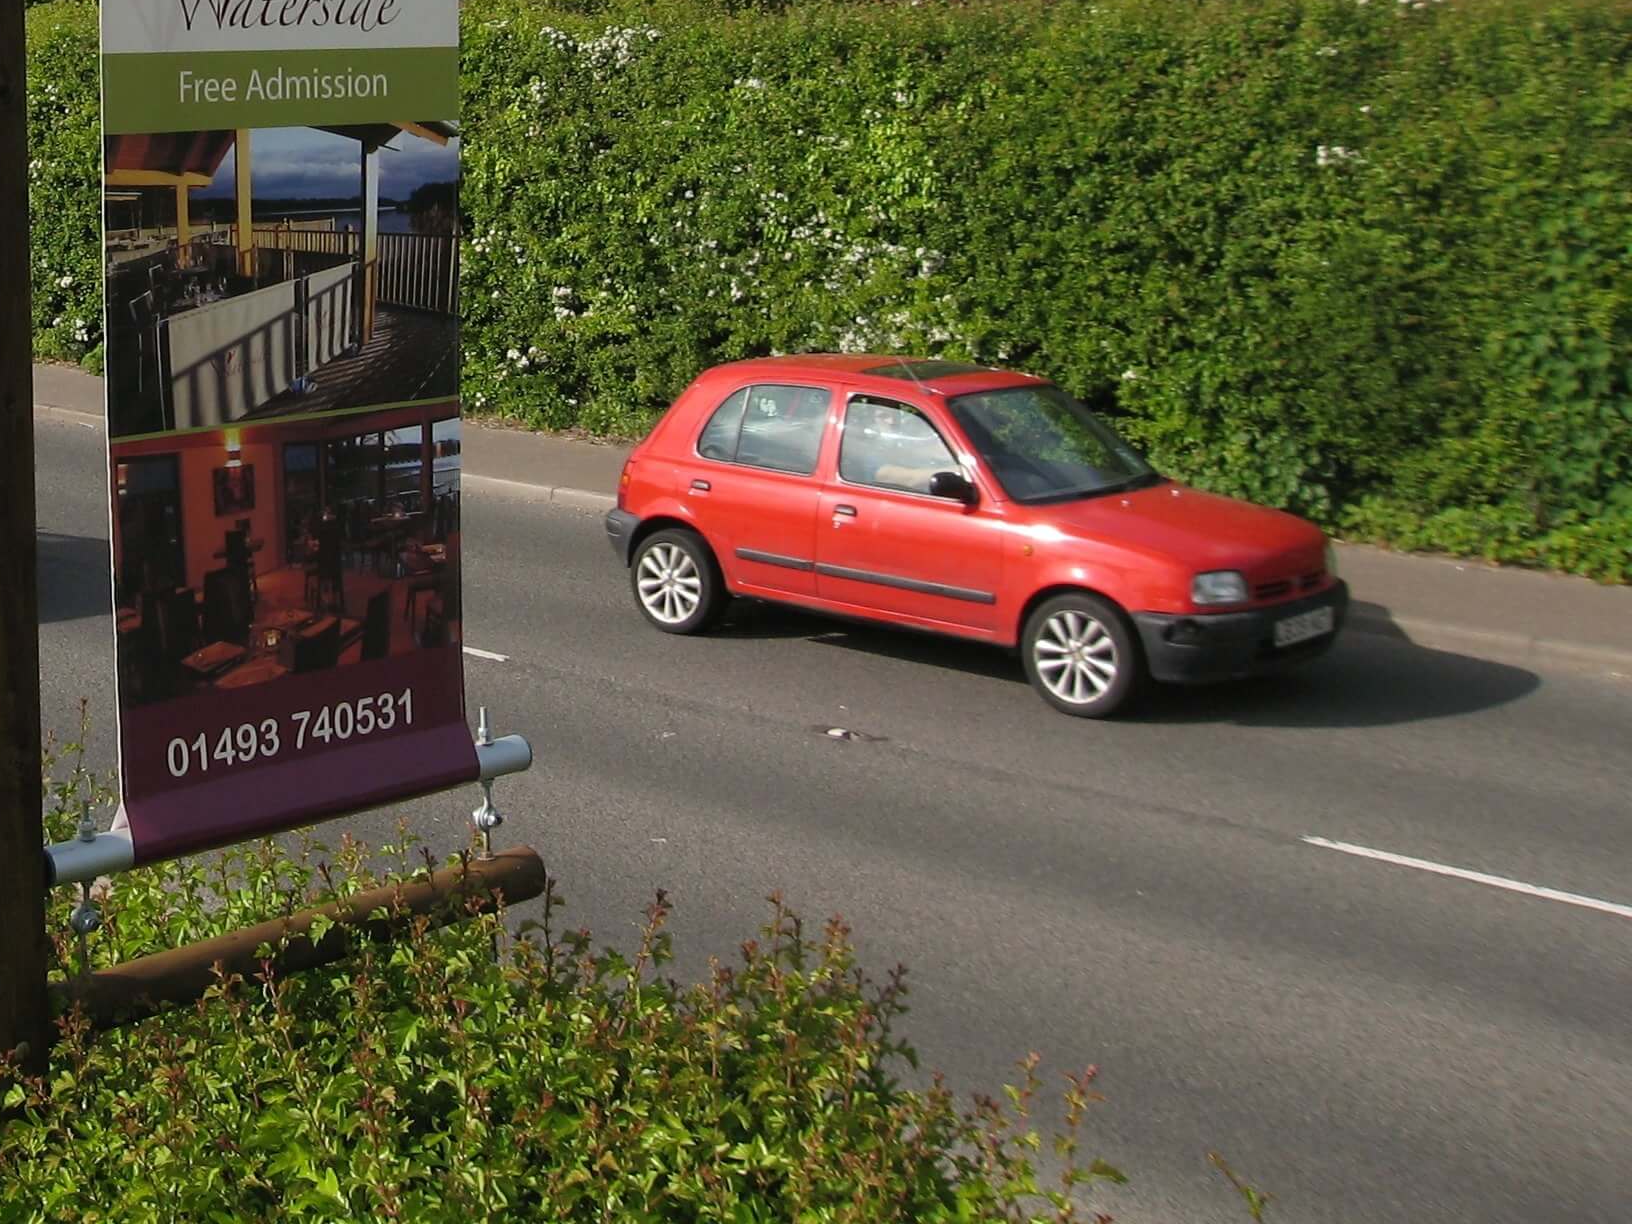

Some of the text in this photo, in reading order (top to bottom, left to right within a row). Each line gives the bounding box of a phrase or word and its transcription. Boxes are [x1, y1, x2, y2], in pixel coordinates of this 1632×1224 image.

[179, 66, 388, 103] Free Admission
[167, 687, 414, 777] 01493 740531
